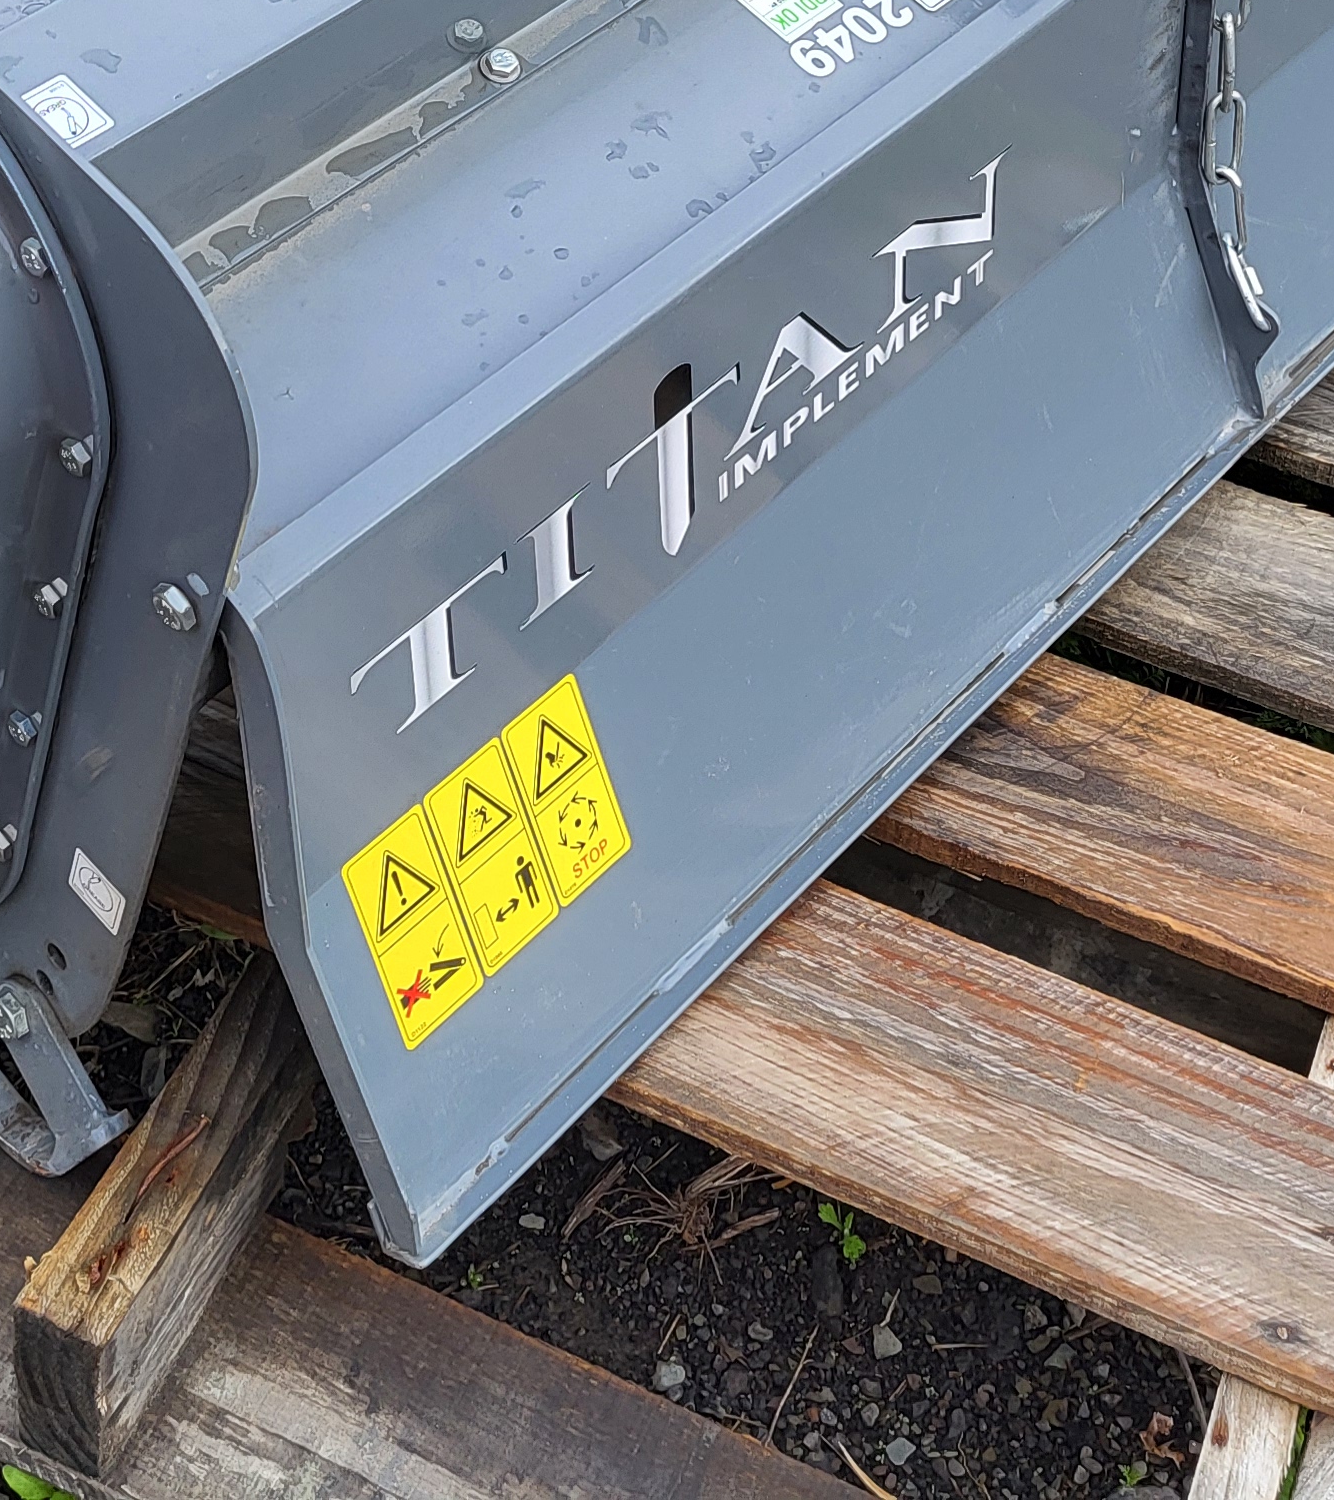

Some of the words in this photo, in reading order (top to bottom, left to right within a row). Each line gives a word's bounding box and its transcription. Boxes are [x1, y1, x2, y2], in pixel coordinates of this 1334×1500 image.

[770, 7, 799, 29] OK
[349, 144, 1013, 733] TITAN
[718, 248, 995, 503] IMPLEMENT
[572, 837, 609, 880] STOP
